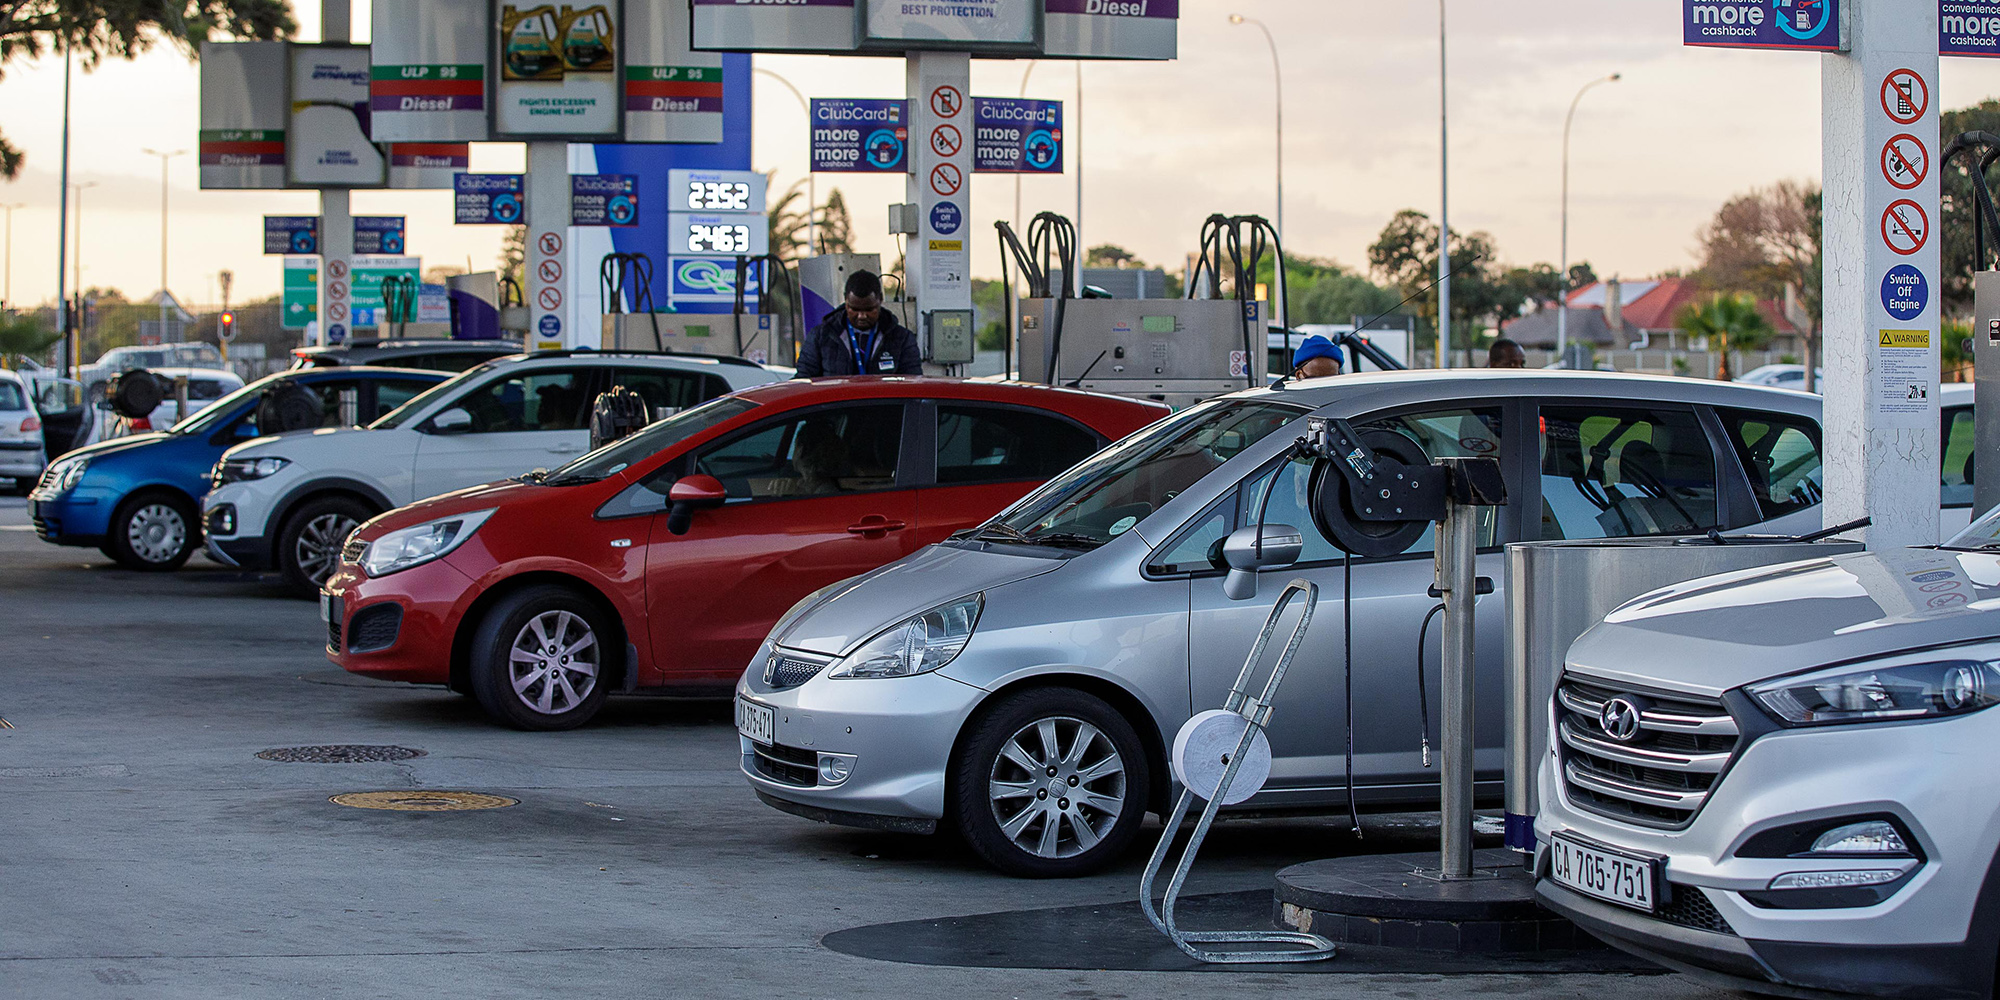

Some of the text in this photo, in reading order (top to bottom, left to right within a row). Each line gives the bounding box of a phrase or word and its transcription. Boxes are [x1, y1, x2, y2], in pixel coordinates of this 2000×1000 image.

[901, 4, 928, 15] BEST
[1086, 0, 1147, 16] Diesel
[1942, 4, 2000, 14] convenience
[1693, 5, 1764, 25] more
[1702, 26, 1757, 36] cashback
[1942, 15, 2000, 36] more
[1950, 36, 1997, 46] cashback
[401, 67, 429, 77] ULP
[653, 68, 678, 79] ULP
[401, 96, 453, 110] Diesel
[652, 98, 700, 111] Diesel
[818, 107, 887, 120] ClubCard
[981, 106, 1046, 121] ClubCard
[815, 129, 860, 141] more
[977, 128, 1020, 140] more
[815, 148, 860, 161] more
[977, 147, 1020, 160] more
[820, 160, 855, 168] cashback
[457, 194, 490, 203] more
[573, 195, 606, 204] more
[457, 208, 490, 217] more
[573, 209, 606, 218] more
[935, 206, 957, 214] Switch
[935, 221, 956, 230] Engine
[1889, 273, 1920, 285] Switch
[1897, 286, 1912, 297] Off
[1246, 304, 1256, 317] 3
[1889, 298, 1920, 312] Engine
[1894, 334, 1928, 344] WARNING
[1555, 841, 1571, 880] CA
